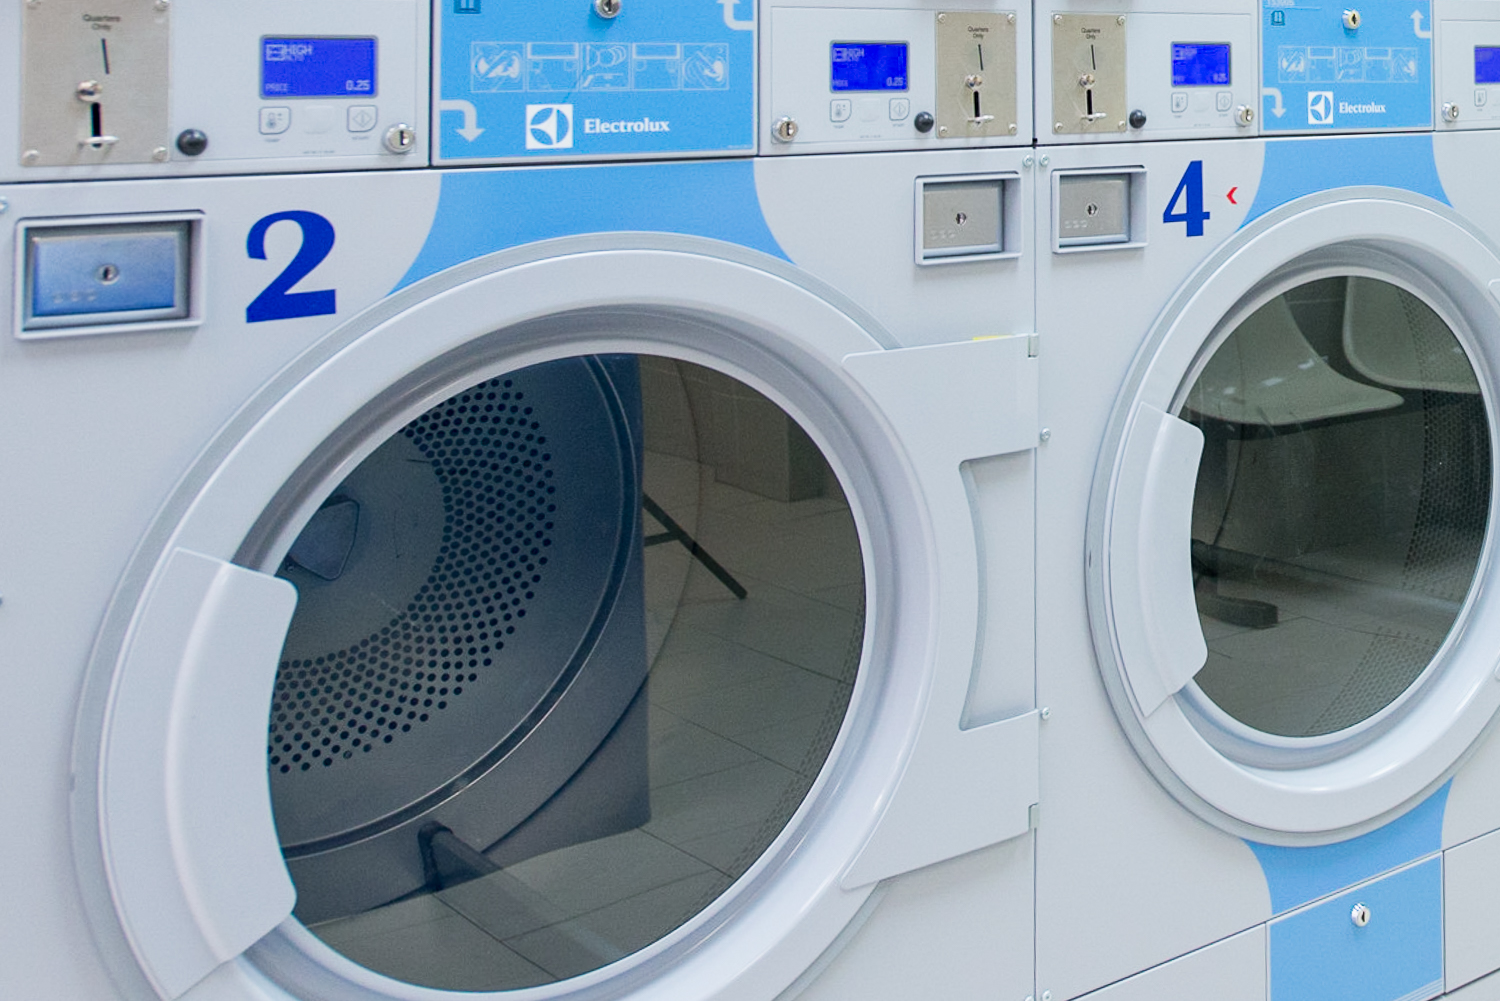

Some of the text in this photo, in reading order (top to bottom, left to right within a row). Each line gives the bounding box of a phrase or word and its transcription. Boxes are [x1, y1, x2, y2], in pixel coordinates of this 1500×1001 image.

[83, 14, 121, 24] Quarters
[92, 22, 111, 32] Only
[283, 44, 313, 56] HIGH
[345, 79, 371, 91] 0.25
[887, 77, 904, 87] 0.25
[1339, 102, 1386, 114] Electrolux
[584, 117, 671, 134] Electrolux
[1162, 159, 1211, 238] 4
[245, 209, 337, 324] 2
